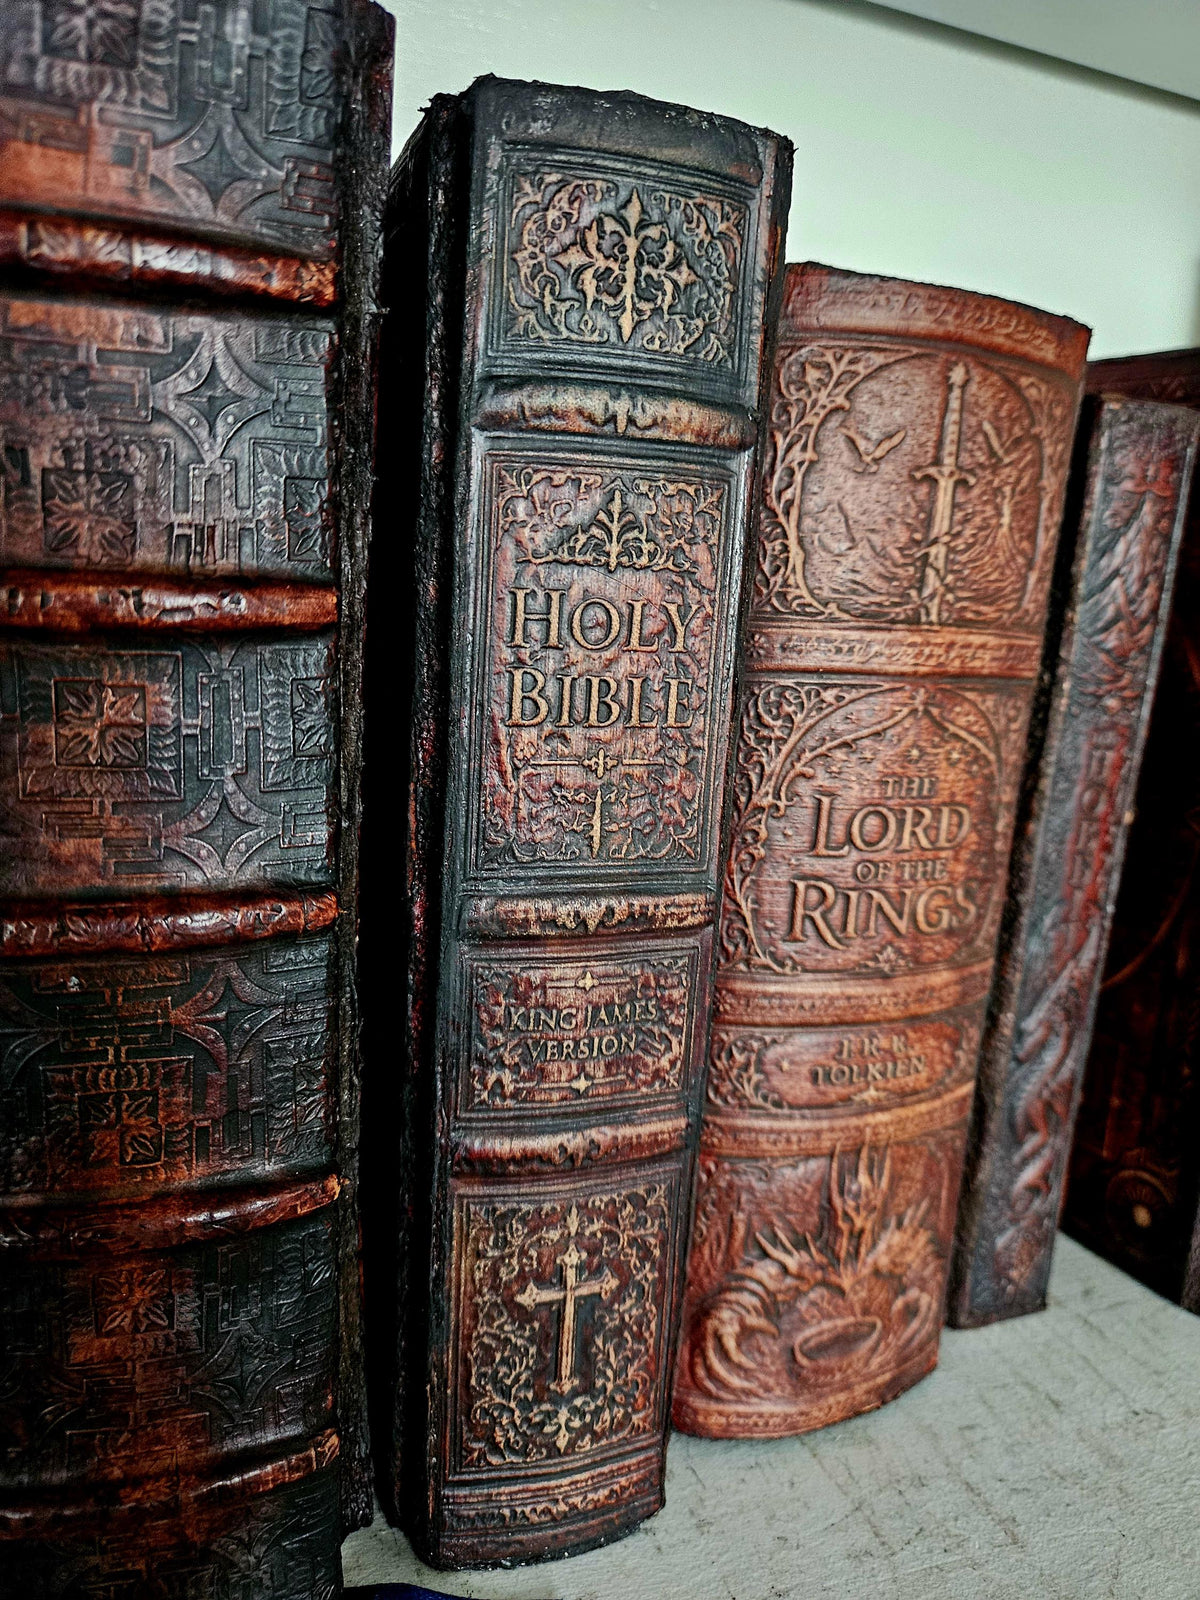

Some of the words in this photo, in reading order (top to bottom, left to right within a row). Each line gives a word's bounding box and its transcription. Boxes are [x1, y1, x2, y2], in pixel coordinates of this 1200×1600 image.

[506, 587, 702, 652] HOLY
[505, 666, 697, 728] BIBLE
[883, 777, 938, 798] THE
[811, 795, 970, 857] LORD
[855, 861, 892, 882] OF
[902, 859, 947, 880] THE
[785, 879, 977, 950] RINGS
[509, 1005, 578, 1032] KING
[585, 1000, 658, 1030] JAMES
[527, 1032, 638, 1062] VERSION
[811, 1054, 927, 1086] TOLKIEN
